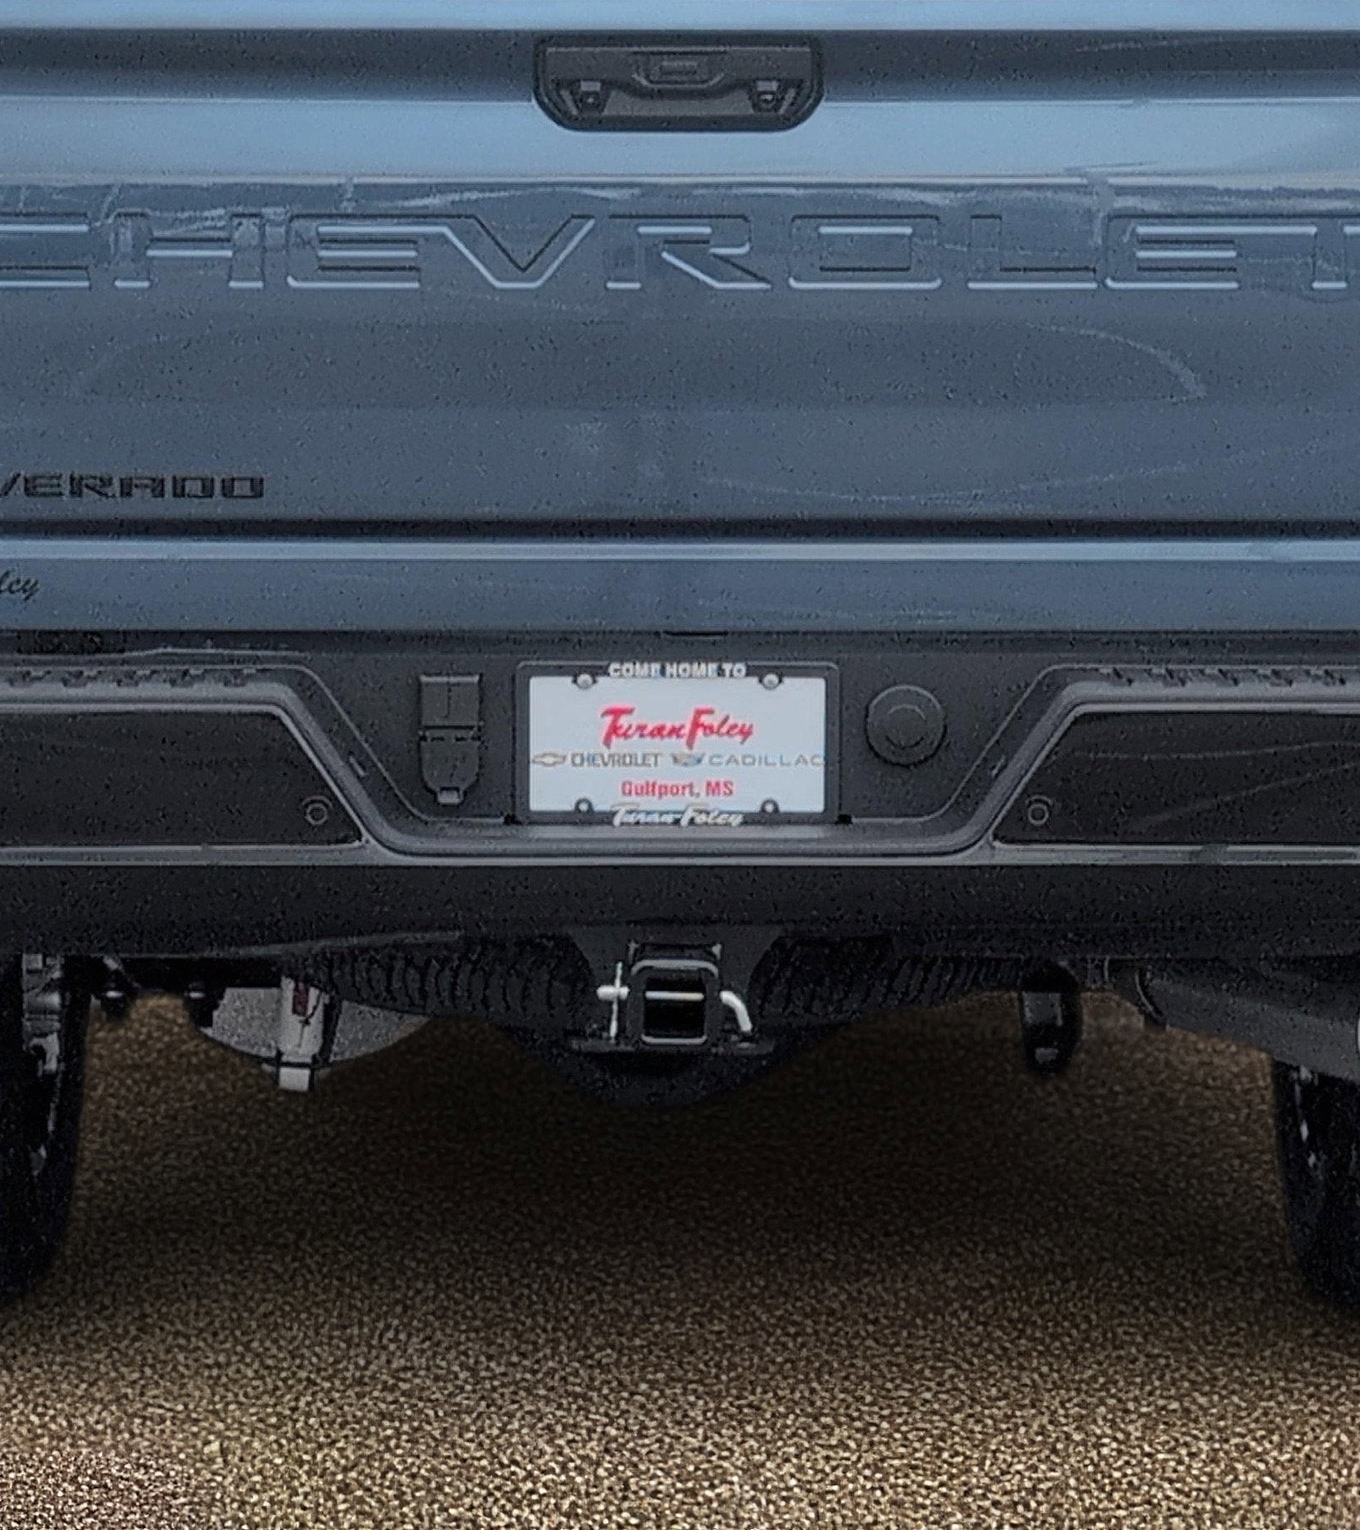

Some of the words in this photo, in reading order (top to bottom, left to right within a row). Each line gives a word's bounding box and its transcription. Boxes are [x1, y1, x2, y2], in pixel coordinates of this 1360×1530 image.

[608, 662, 663, 678] COME
[665, 662, 719, 678] HOME
[722, 662, 747, 678] TO
[600, 705, 685, 750] Turan
[686, 707, 754, 751] Foley
[570, 752, 661, 768] CHEVROLET
[708, 753, 825, 767] CADILLAC
[621, 780, 701, 799] Gulfport,
[705, 780, 734, 797] MS
